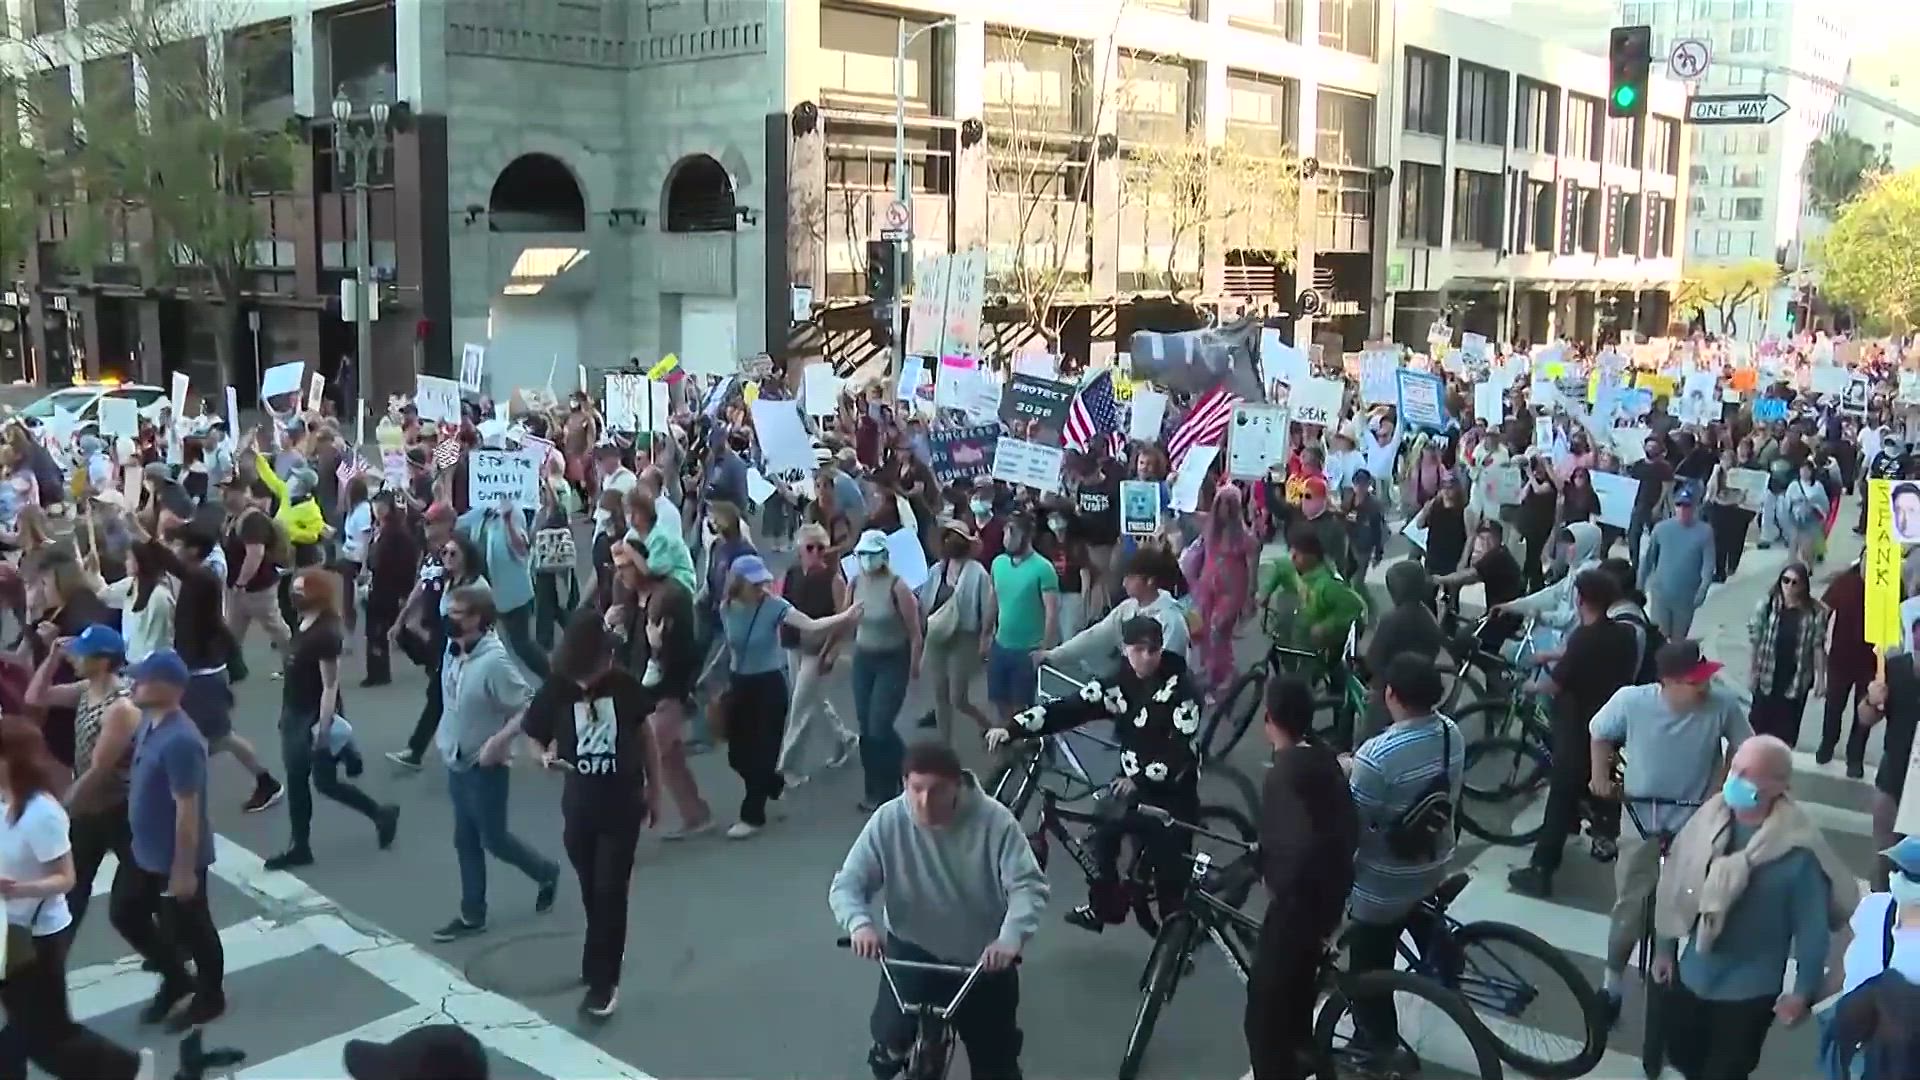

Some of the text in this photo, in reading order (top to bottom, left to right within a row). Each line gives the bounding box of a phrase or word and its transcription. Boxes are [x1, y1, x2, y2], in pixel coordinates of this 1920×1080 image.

[1696, 102, 1767, 117] ONE WAY
[1011, 382, 1070, 402] PROTECT
[1298, 405, 1329, 422] SPEAK
